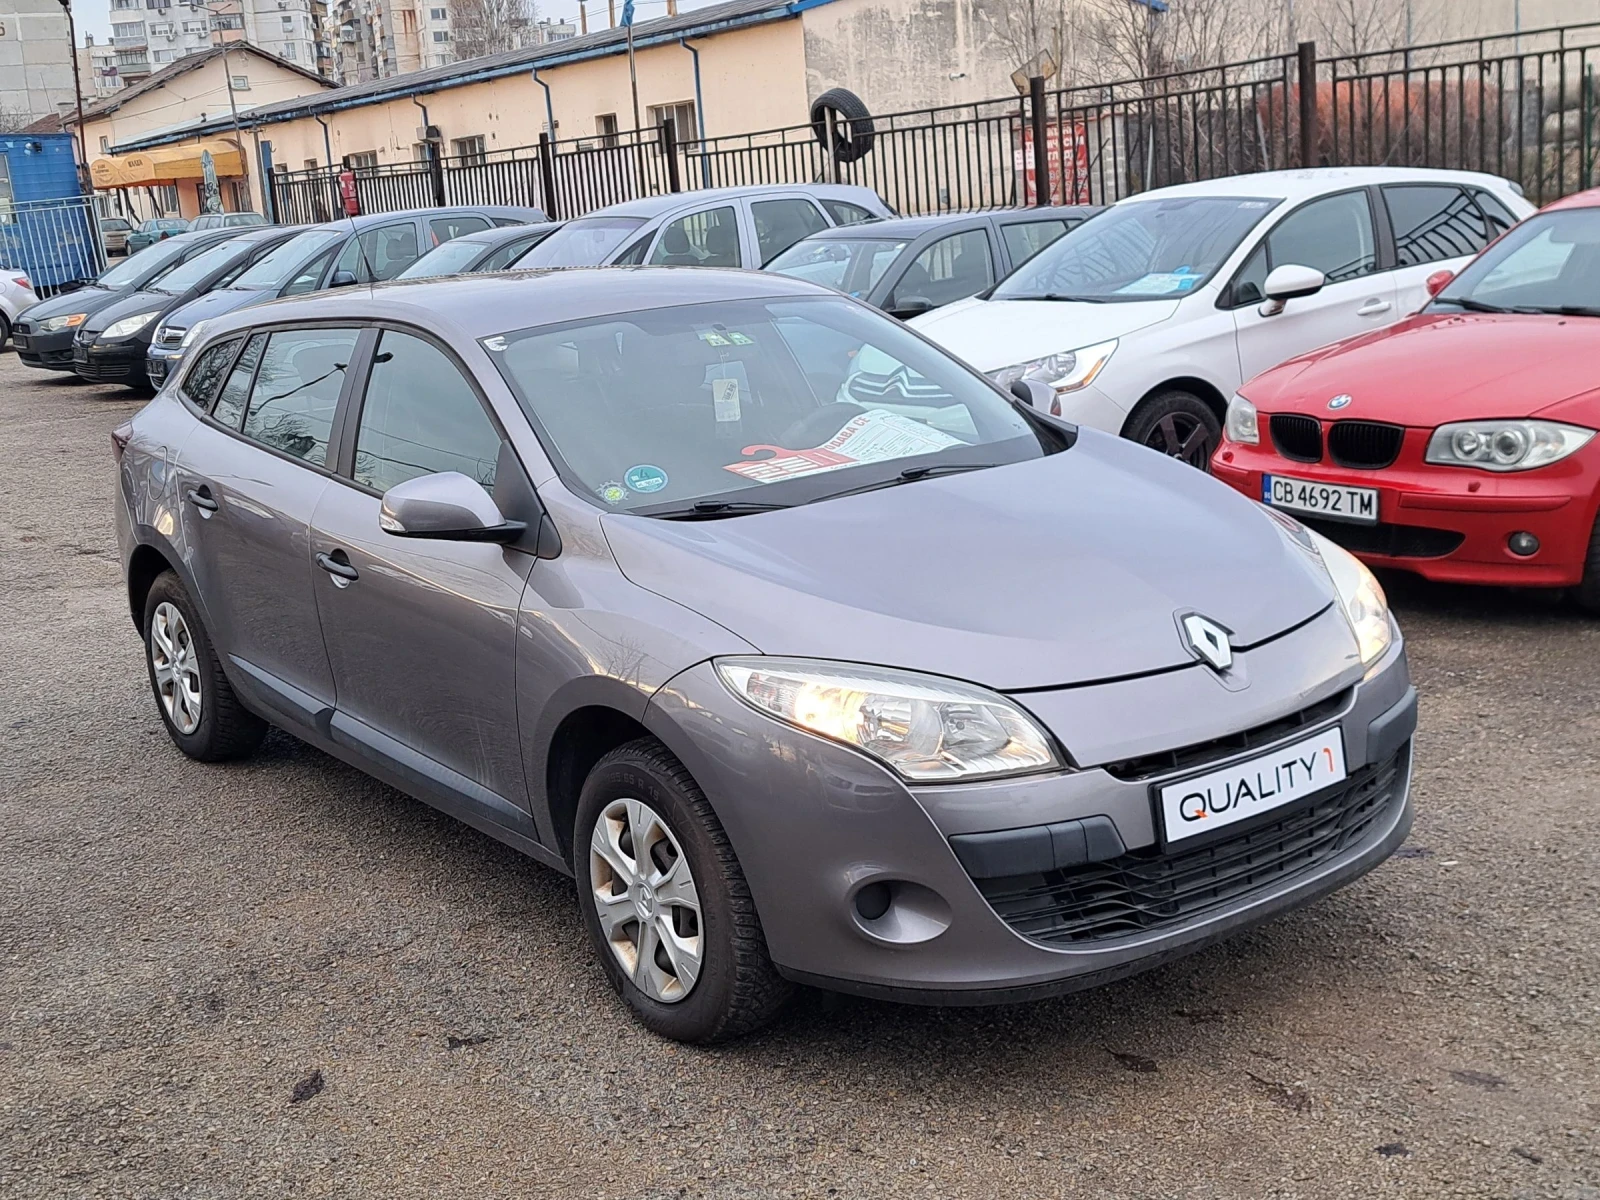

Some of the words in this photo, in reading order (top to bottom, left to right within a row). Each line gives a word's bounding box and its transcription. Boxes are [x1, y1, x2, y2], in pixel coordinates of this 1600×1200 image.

[824, 427, 858, 450] ОДАВА
[854, 416, 871, 427] СЕ
[1273, 480, 1294, 503] CB
[1298, 485, 1342, 511] 4692
[1346, 491, 1372, 515] TM
[1179, 752, 1317, 822] QUALITY
